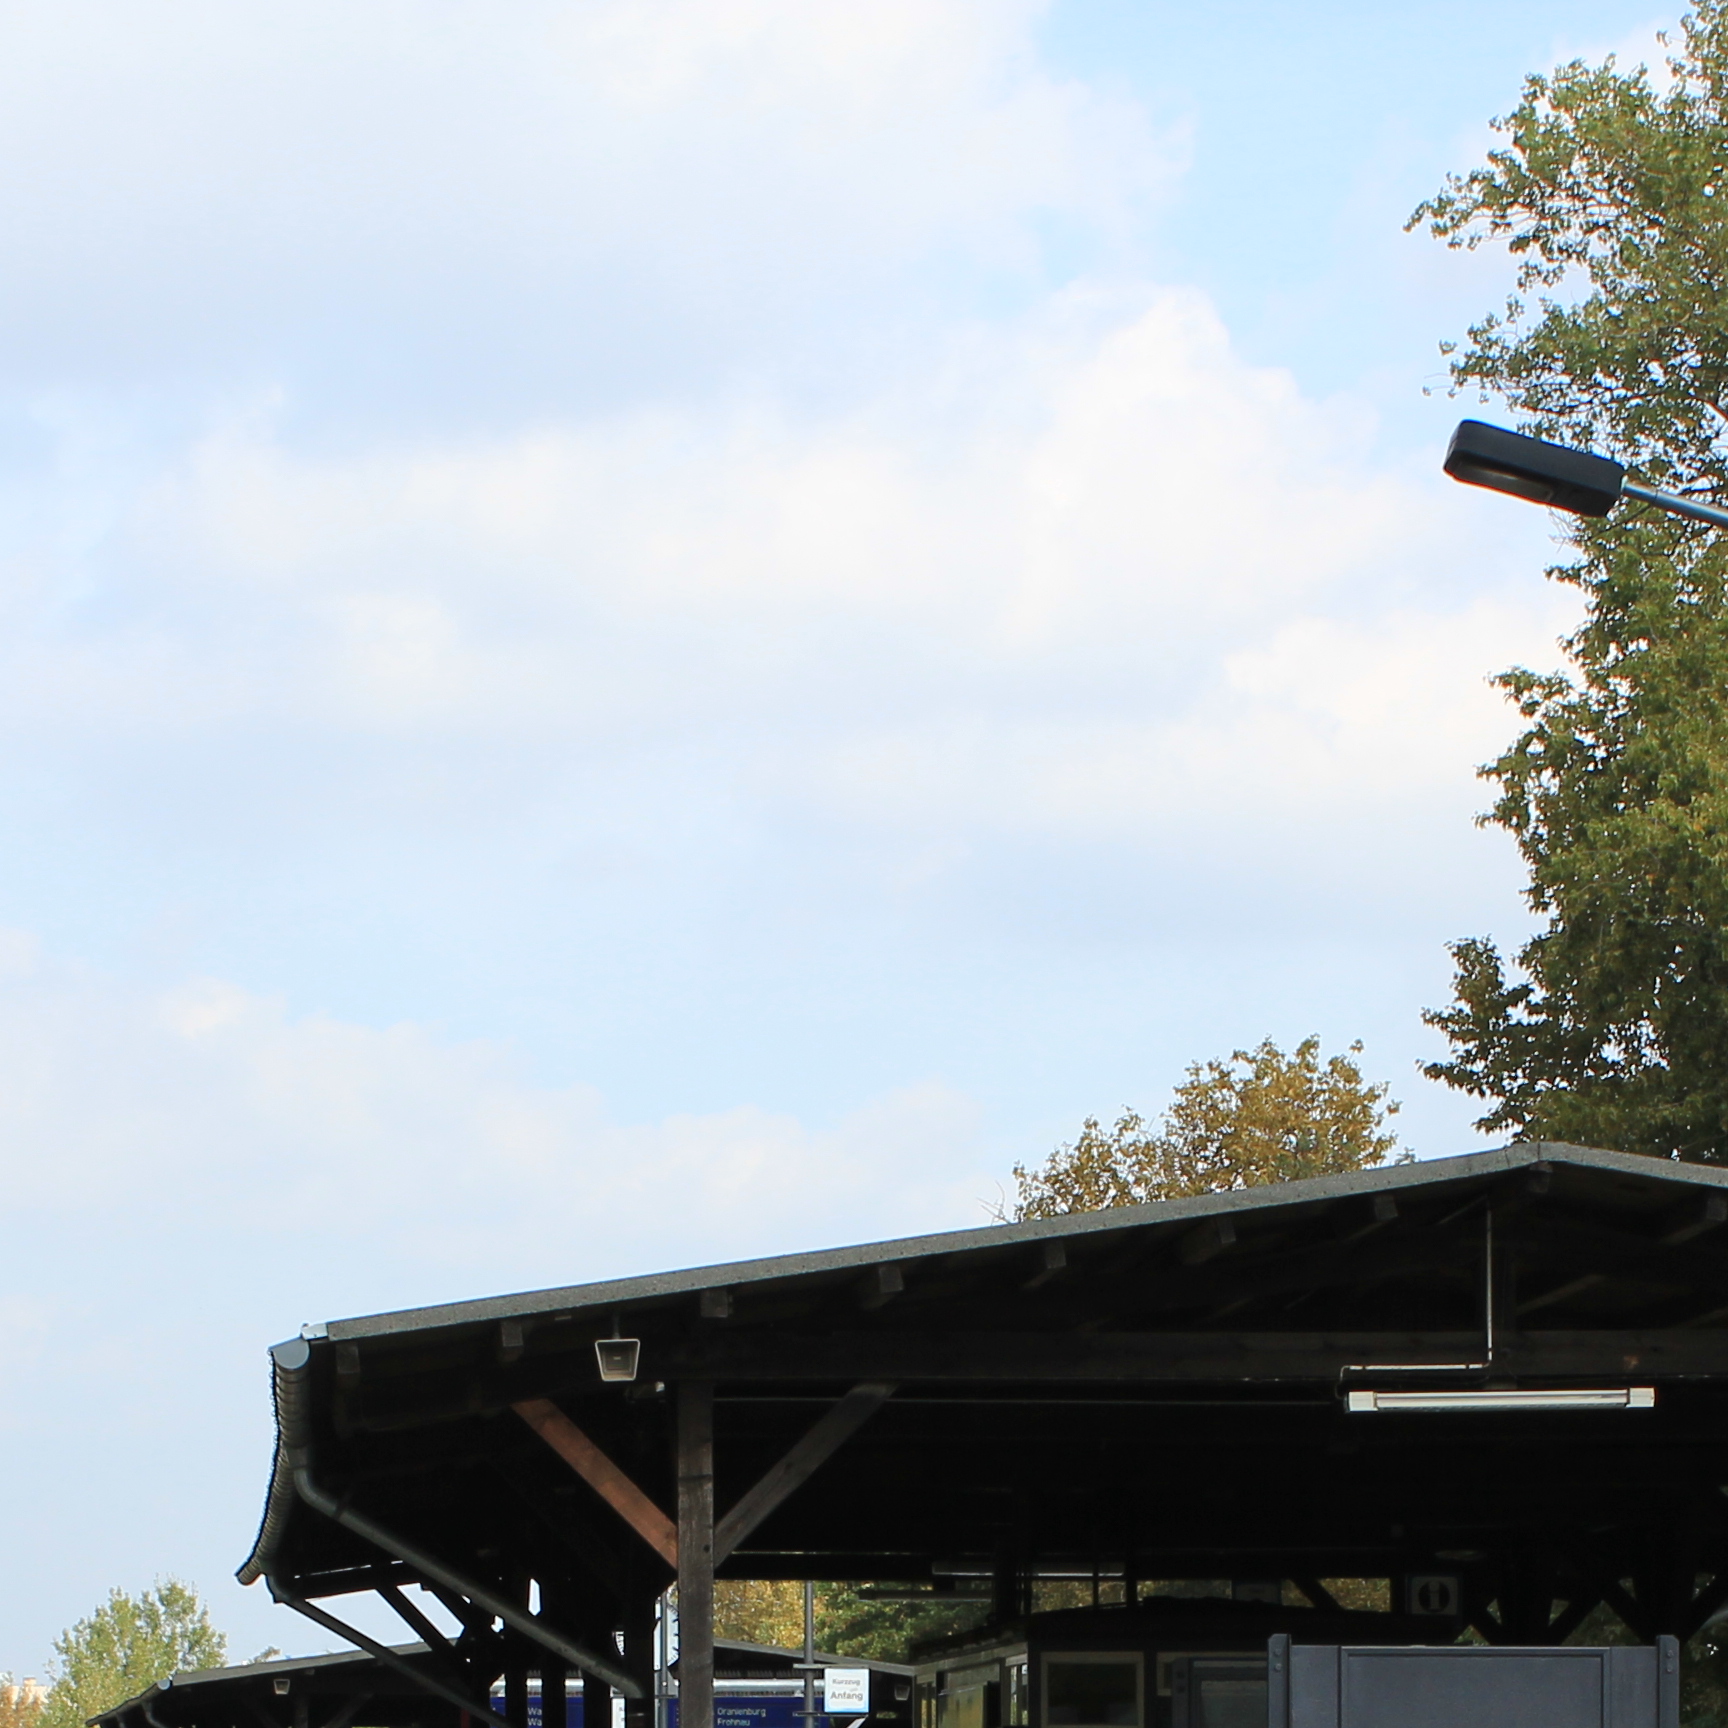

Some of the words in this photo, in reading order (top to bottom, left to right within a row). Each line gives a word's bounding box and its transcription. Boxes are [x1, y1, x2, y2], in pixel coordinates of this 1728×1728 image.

[829, 1691, 864, 1702] Anfang
[717, 1707, 767, 1718] Oranienburg
[717, 1718, 751, 1727] Frohnau
